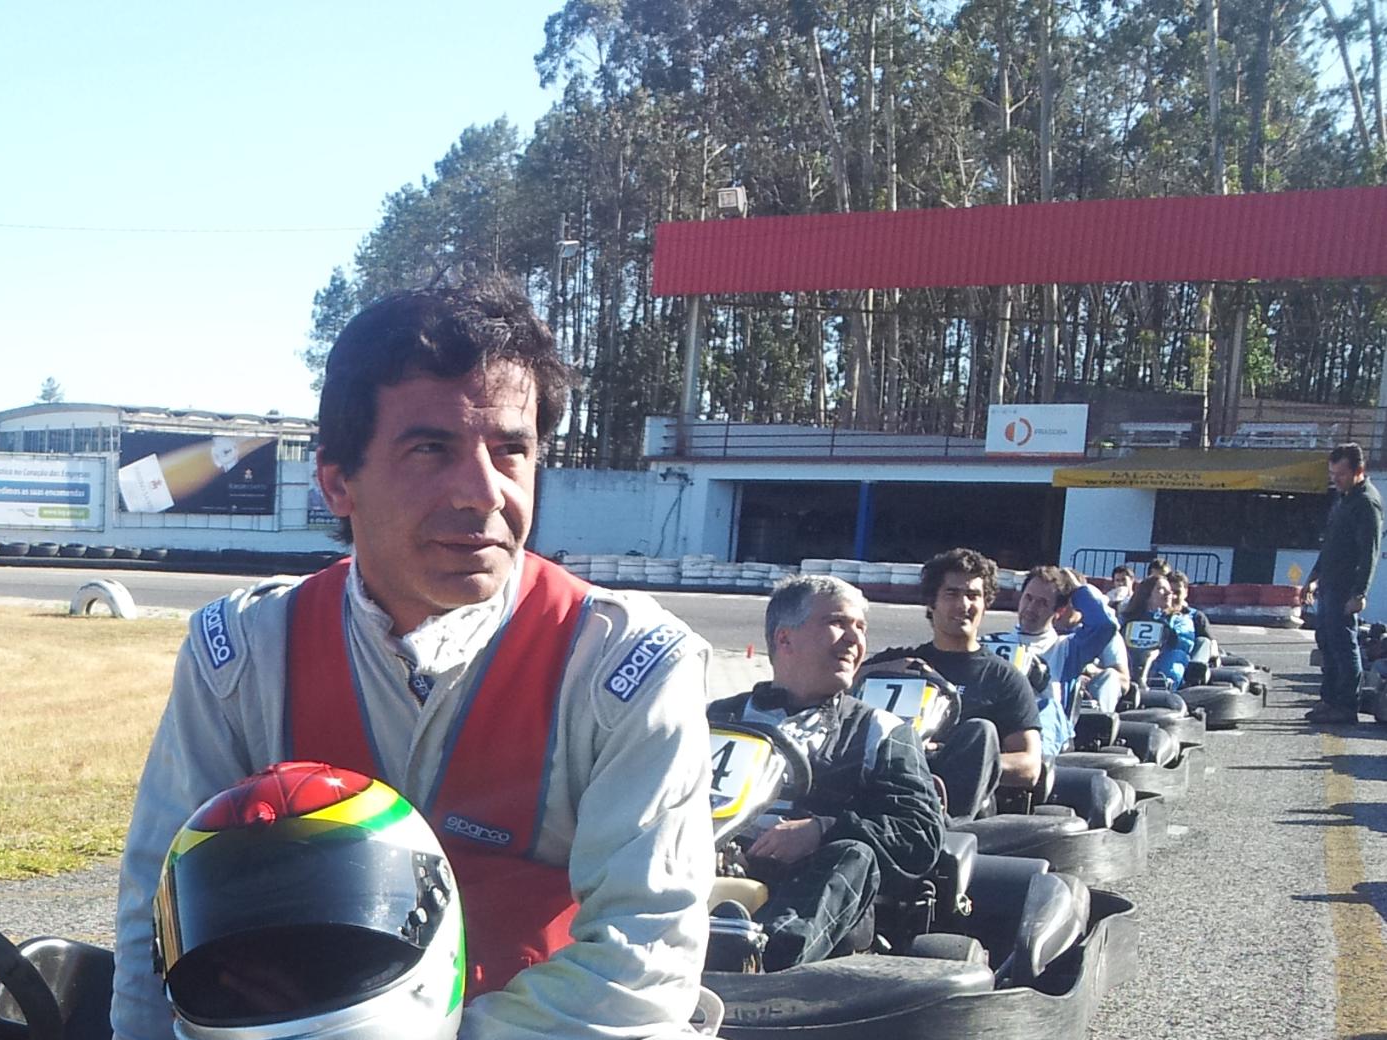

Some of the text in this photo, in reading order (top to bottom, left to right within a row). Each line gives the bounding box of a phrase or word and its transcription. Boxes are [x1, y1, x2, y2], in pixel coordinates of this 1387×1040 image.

[1139, 623, 1153, 640] 2
[885, 683, 903, 713] 7
[711, 740, 737, 792] 4
[447, 816, 510, 841] sparco
